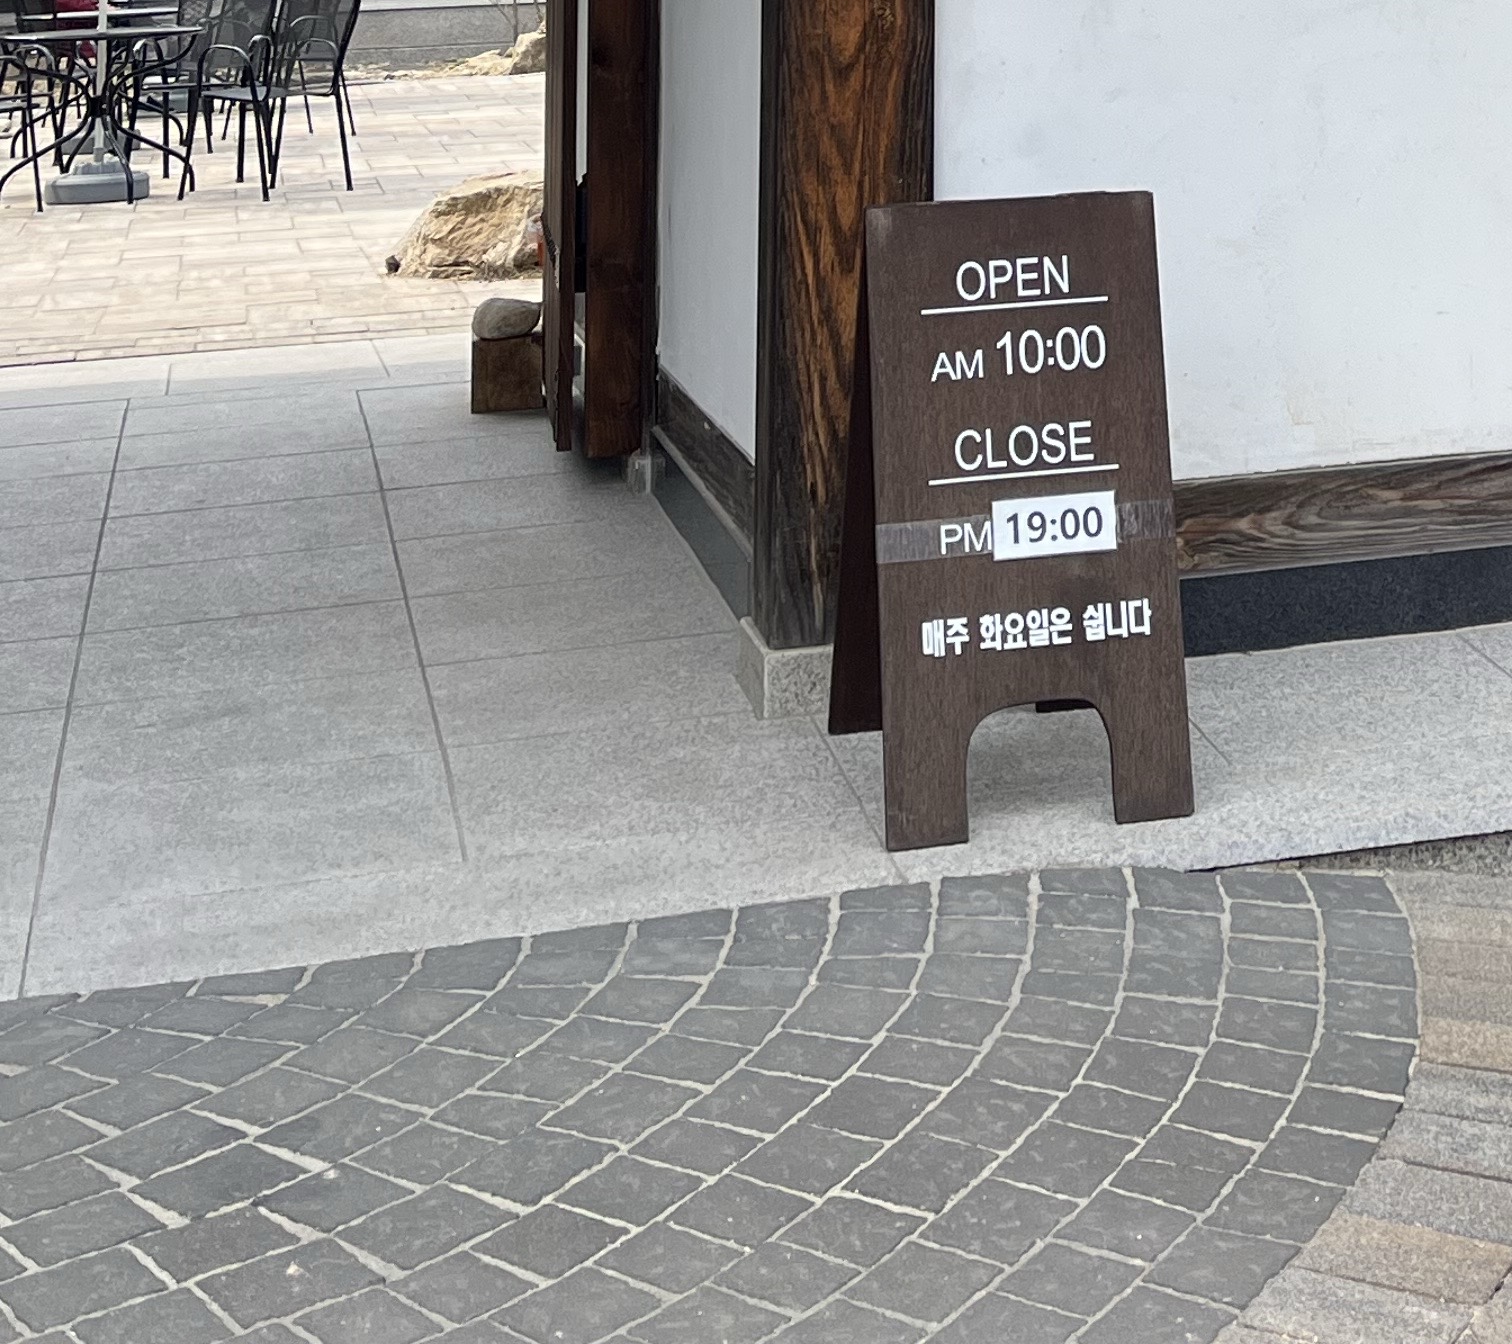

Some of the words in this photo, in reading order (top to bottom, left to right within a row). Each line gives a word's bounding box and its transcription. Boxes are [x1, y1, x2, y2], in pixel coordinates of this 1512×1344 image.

[955, 255, 1070, 301] OPEN
[931, 348, 984, 382] AM
[996, 324, 1107, 376] 10:00
[954, 420, 1095, 471] CLOSE
[939, 522, 993, 555] PM
[1006, 506, 1104, 545] 19:00
[921, 616, 970, 657] 매주
[979, 606, 1073, 651] 화요일은
[1082, 597, 1152, 642] 쉽니다
